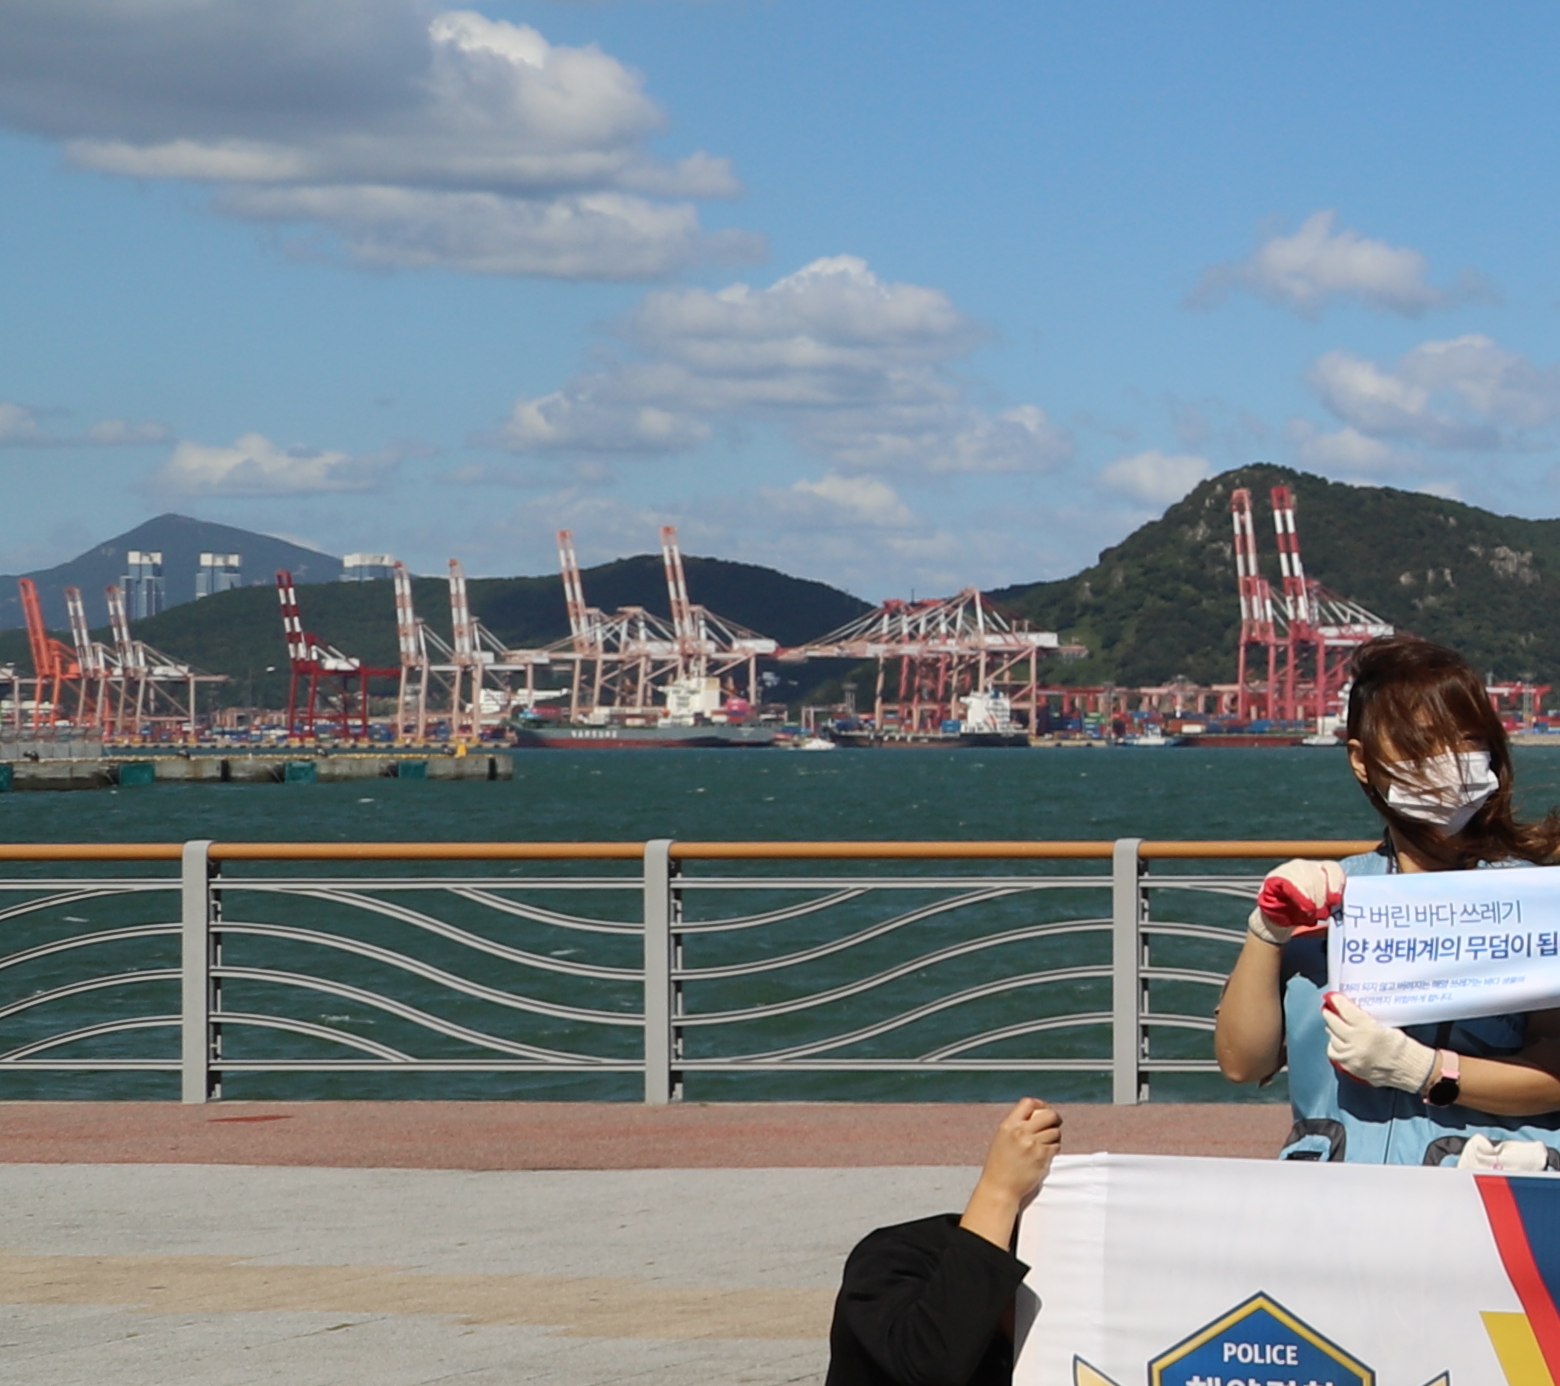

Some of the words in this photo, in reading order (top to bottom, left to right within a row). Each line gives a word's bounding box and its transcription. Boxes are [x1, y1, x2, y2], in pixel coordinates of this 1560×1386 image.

[1369, 903, 1411, 929] 버린
[1414, 902, 1457, 927] 바다
[1459, 899, 1523, 925] 쓰레기
[1342, 936, 1370, 964] 양
[1372, 933, 1461, 965] 생태계의
[1465, 931, 1532, 961] 무덤이
[1223, 1342, 1298, 1366] POLICE
